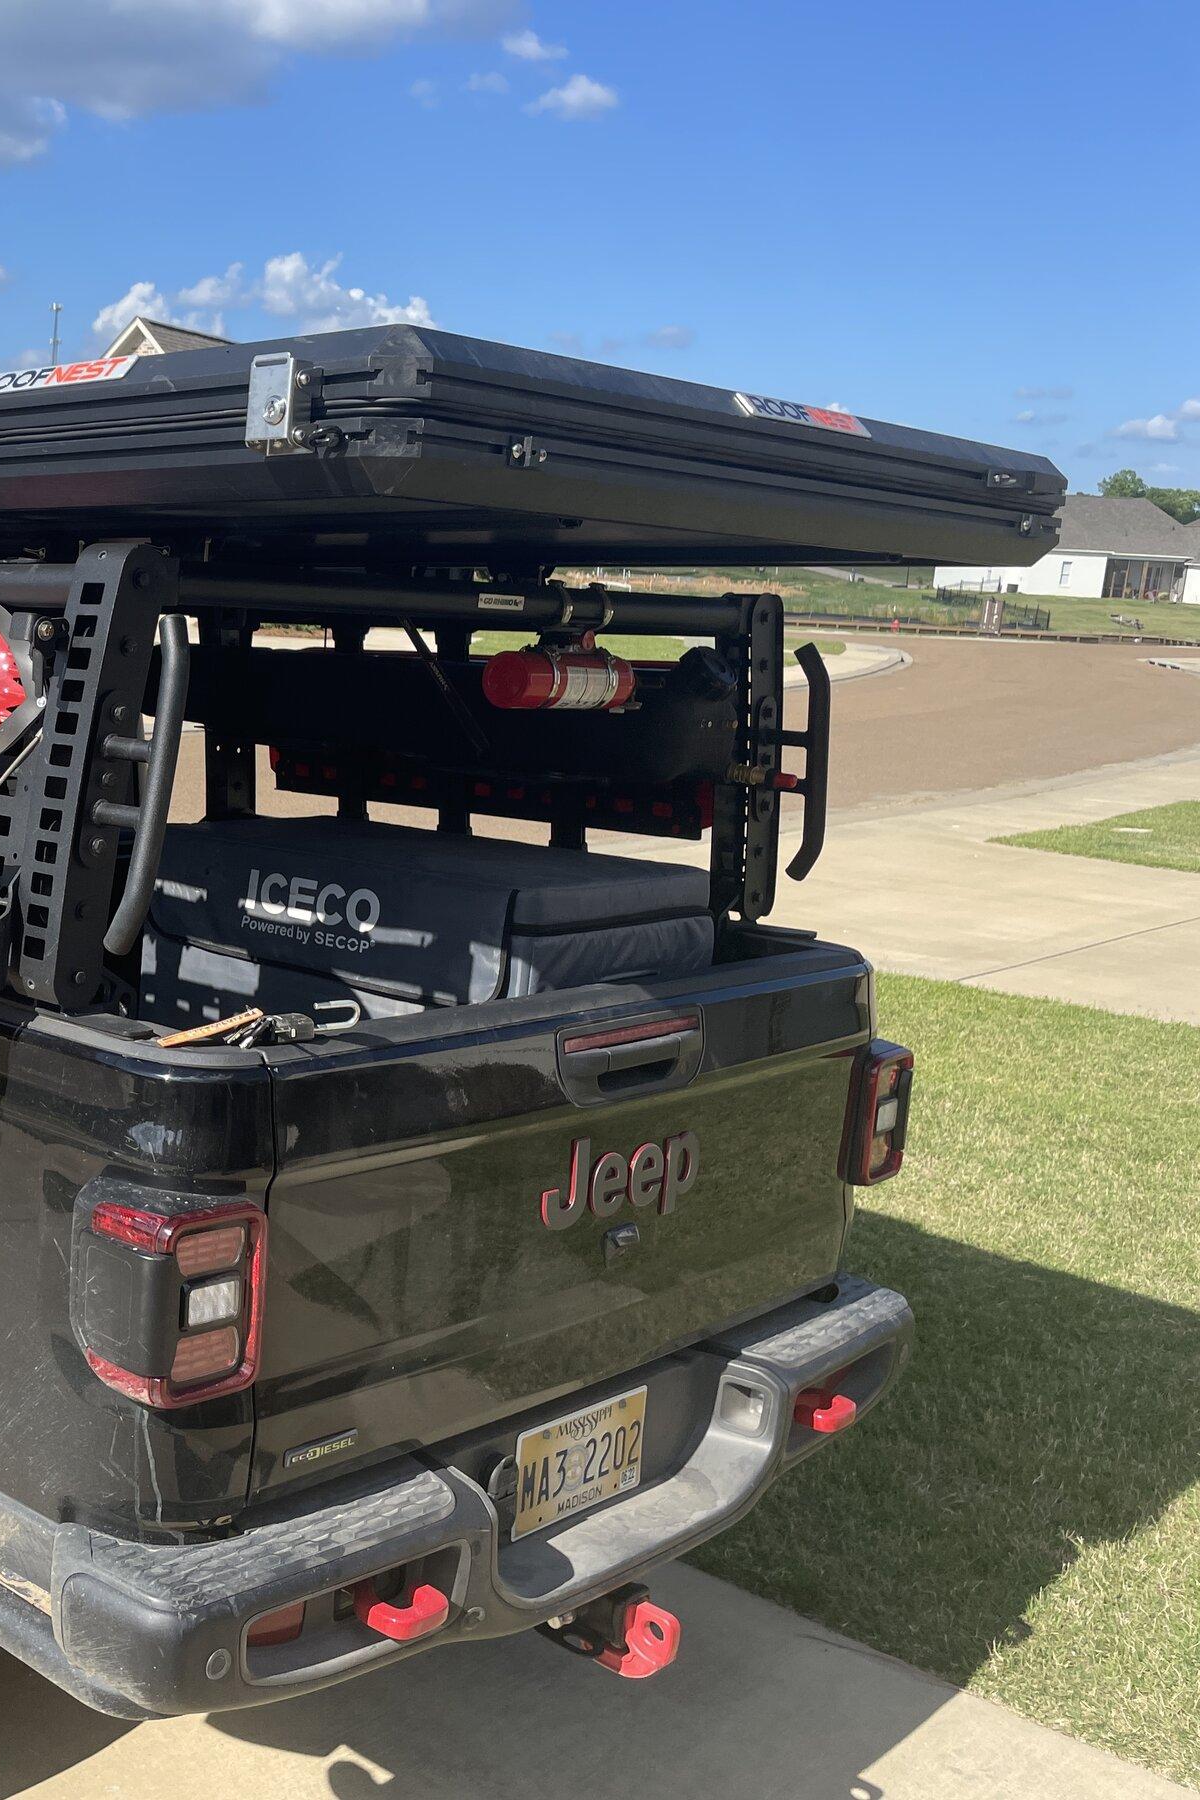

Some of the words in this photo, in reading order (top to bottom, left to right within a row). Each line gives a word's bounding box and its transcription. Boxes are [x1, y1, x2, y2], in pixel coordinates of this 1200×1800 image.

[244, 868, 380, 933] ICECO
[241, 915, 294, 938] Powered
[296, 926, 311, 945] by
[541, 1131, 700, 1231] Jeep
[556, 1404, 614, 1441] MISSISSIPPI
[582, 1419, 641, 1485] 2202
[557, 1485, 604, 1516] MADISON
